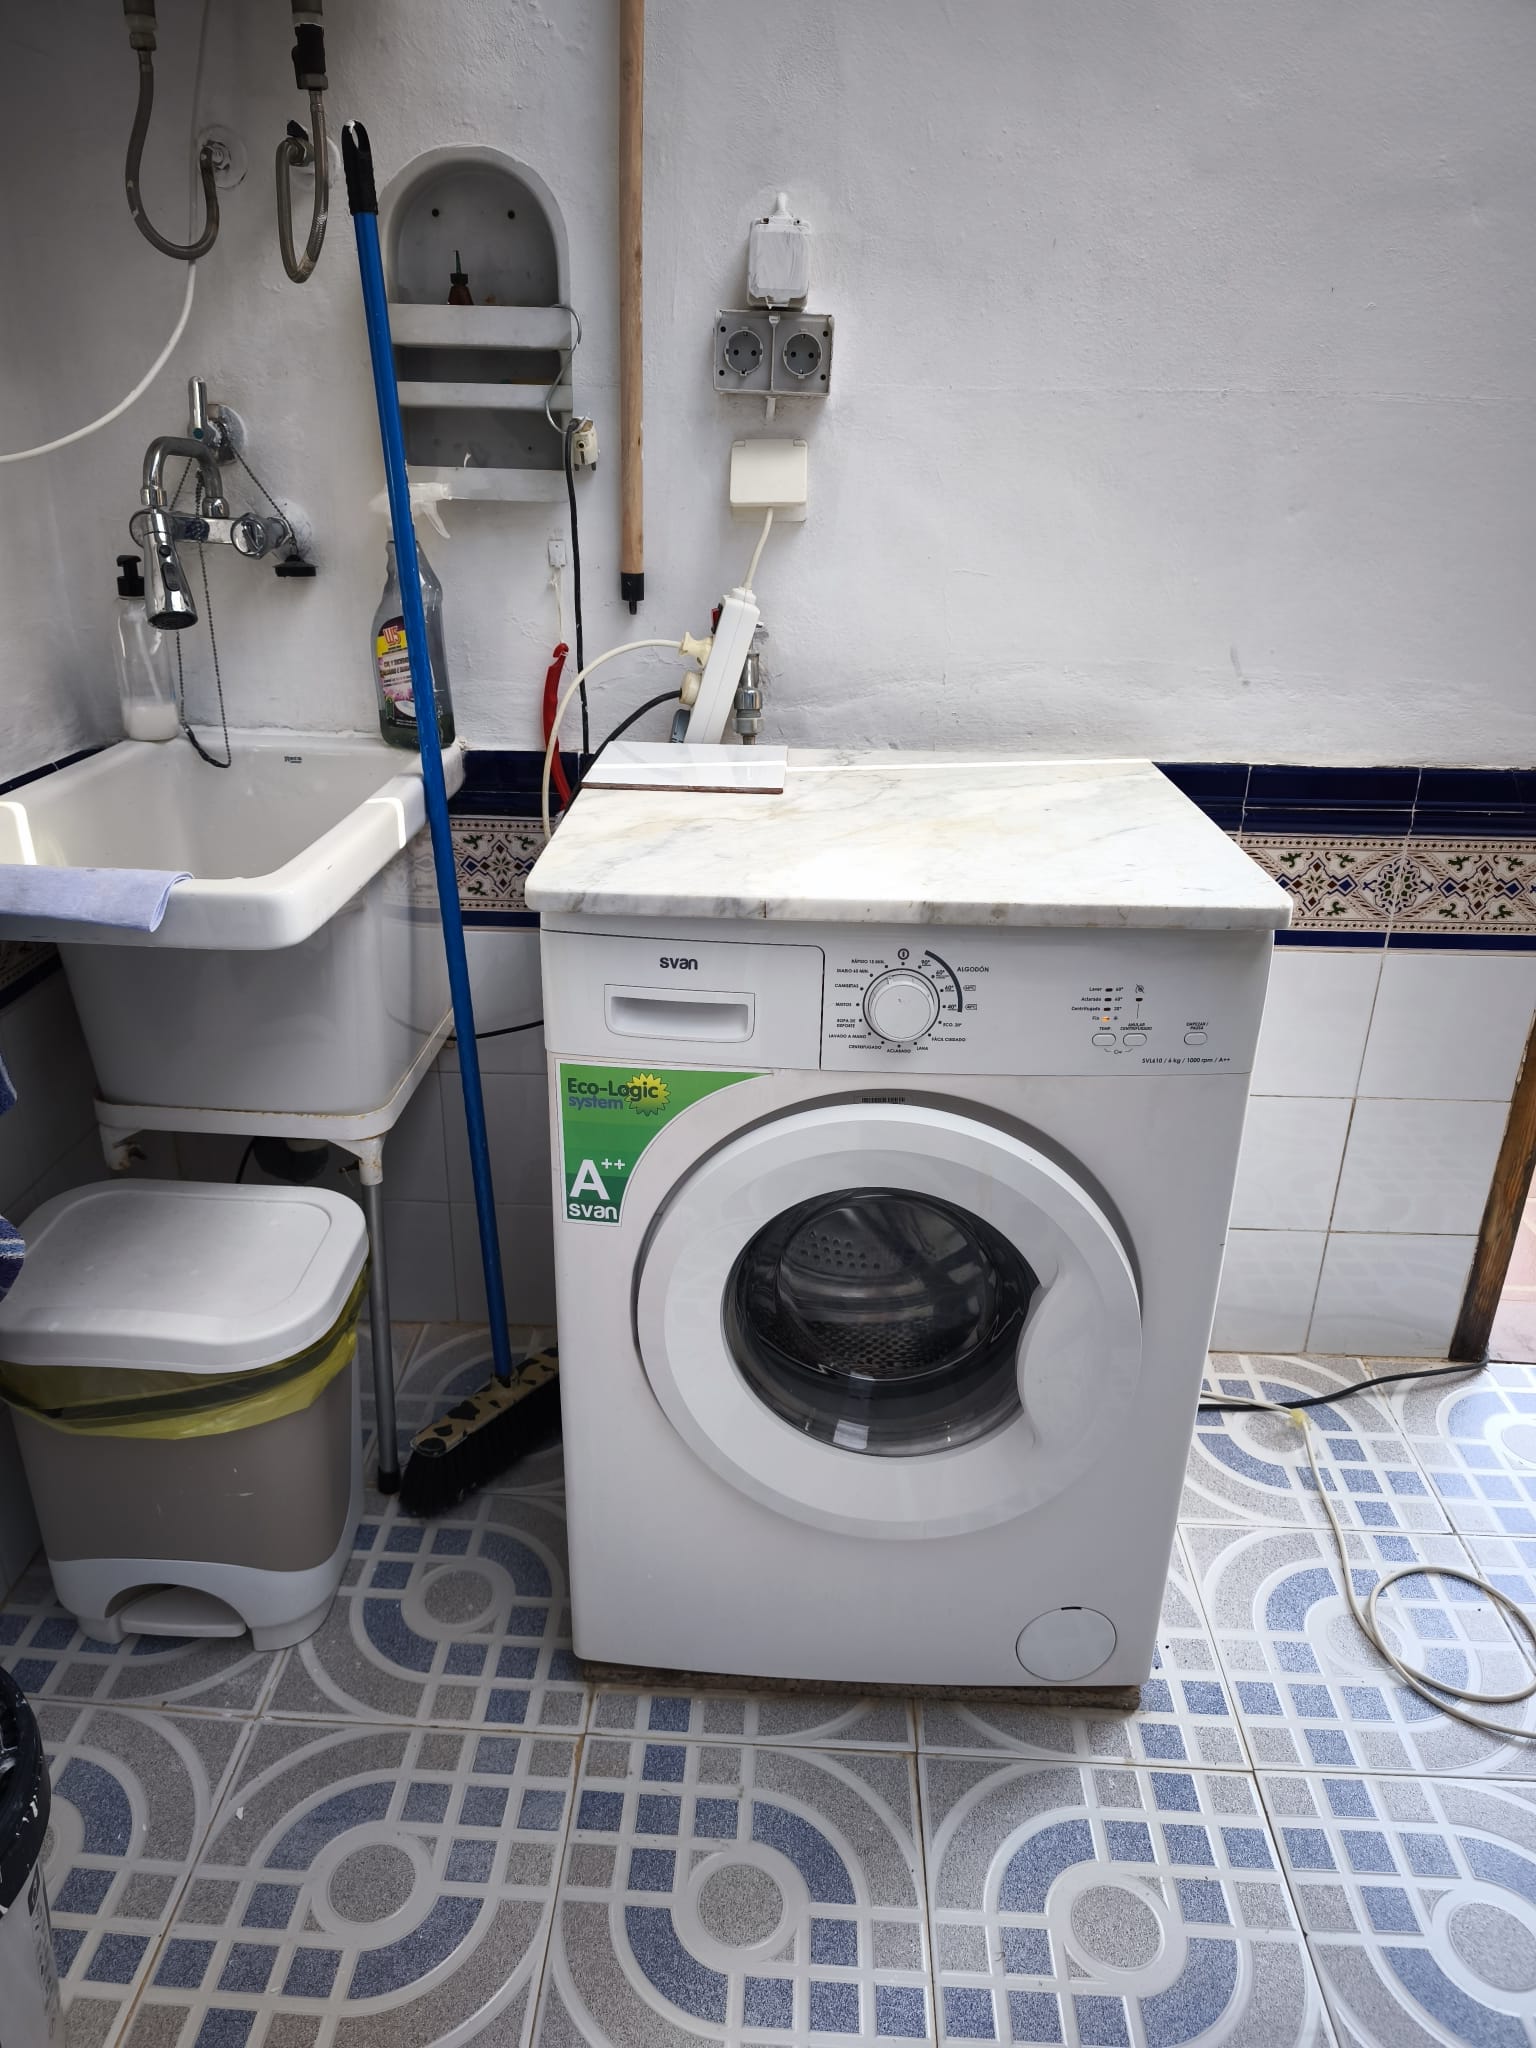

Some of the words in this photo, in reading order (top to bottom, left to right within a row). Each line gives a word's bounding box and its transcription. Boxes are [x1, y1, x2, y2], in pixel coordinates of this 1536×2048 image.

[660, 957, 698, 970] svan
[567, 1078, 659, 1101] Eco-Logic
[568, 1095, 624, 1111] system
[568, 1203, 618, 1220] svan
